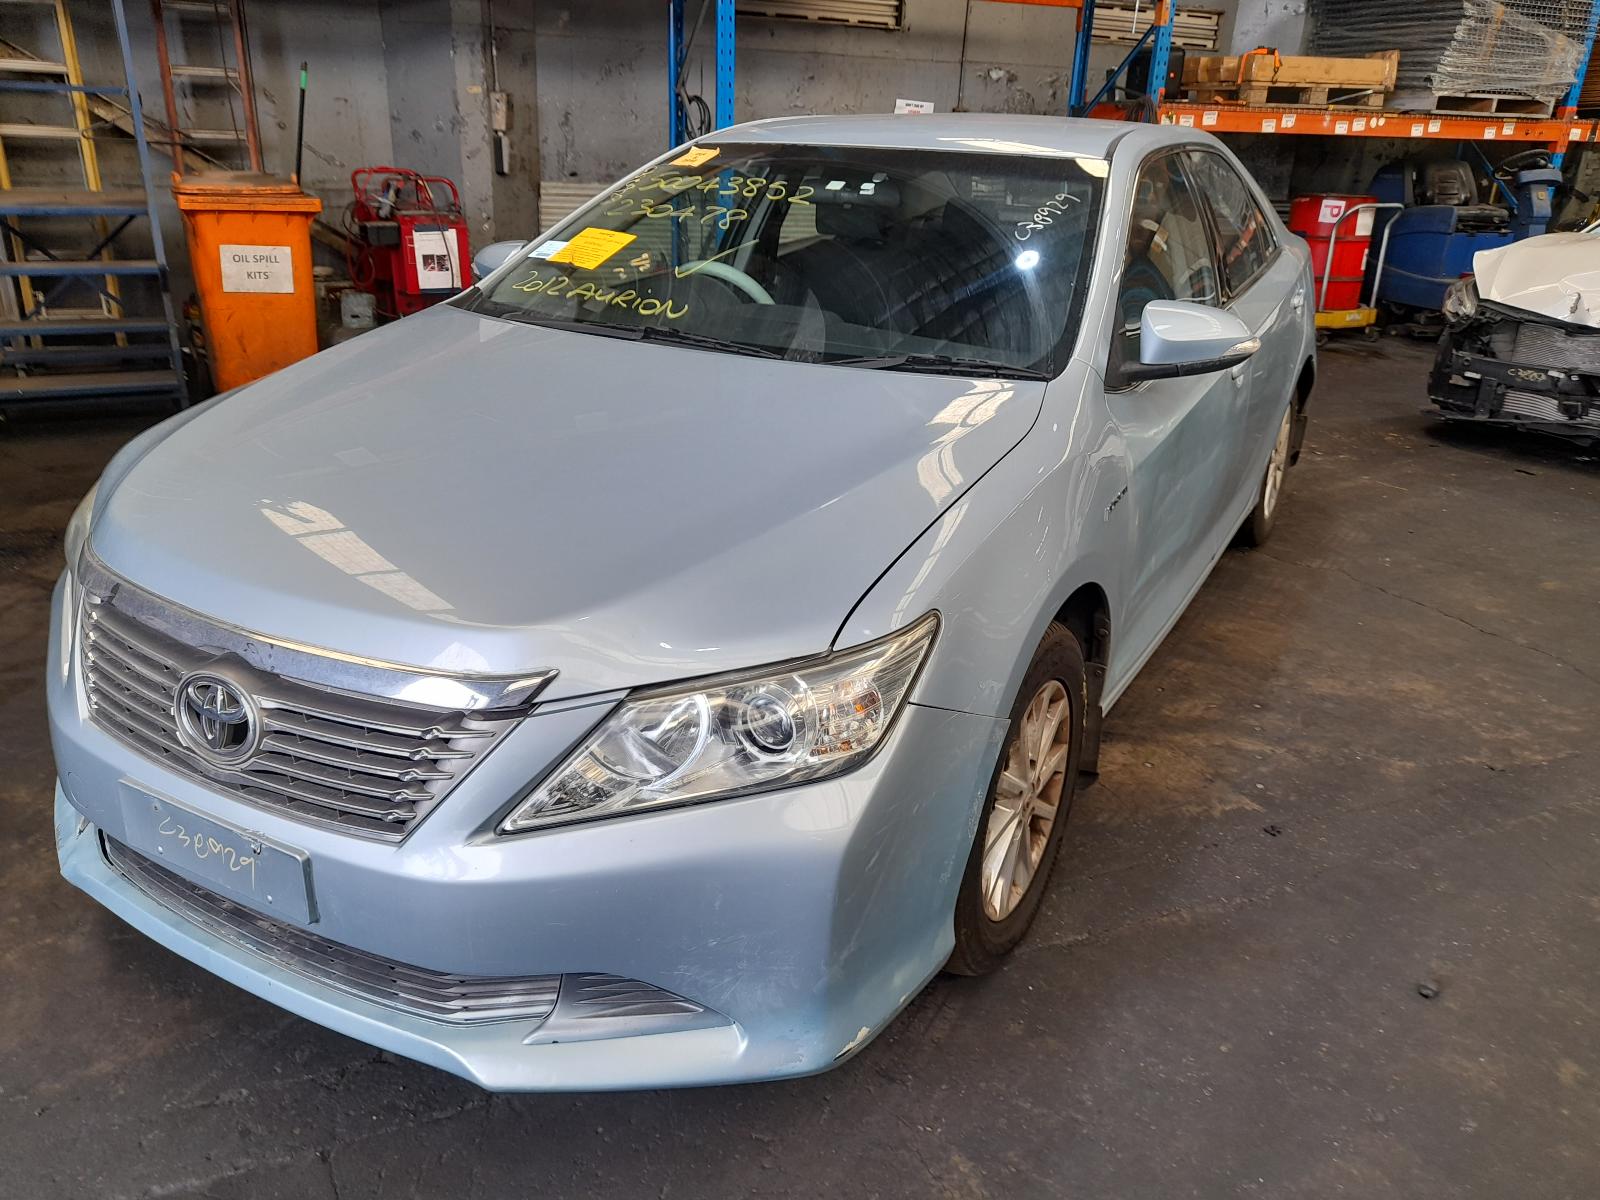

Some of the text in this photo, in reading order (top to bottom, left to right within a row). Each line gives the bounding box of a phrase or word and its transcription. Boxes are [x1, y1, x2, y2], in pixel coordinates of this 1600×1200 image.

[232, 254, 280, 264] OIL SPILL
[246, 271, 270, 280] KITS
[511, 270, 570, 296] 2012
